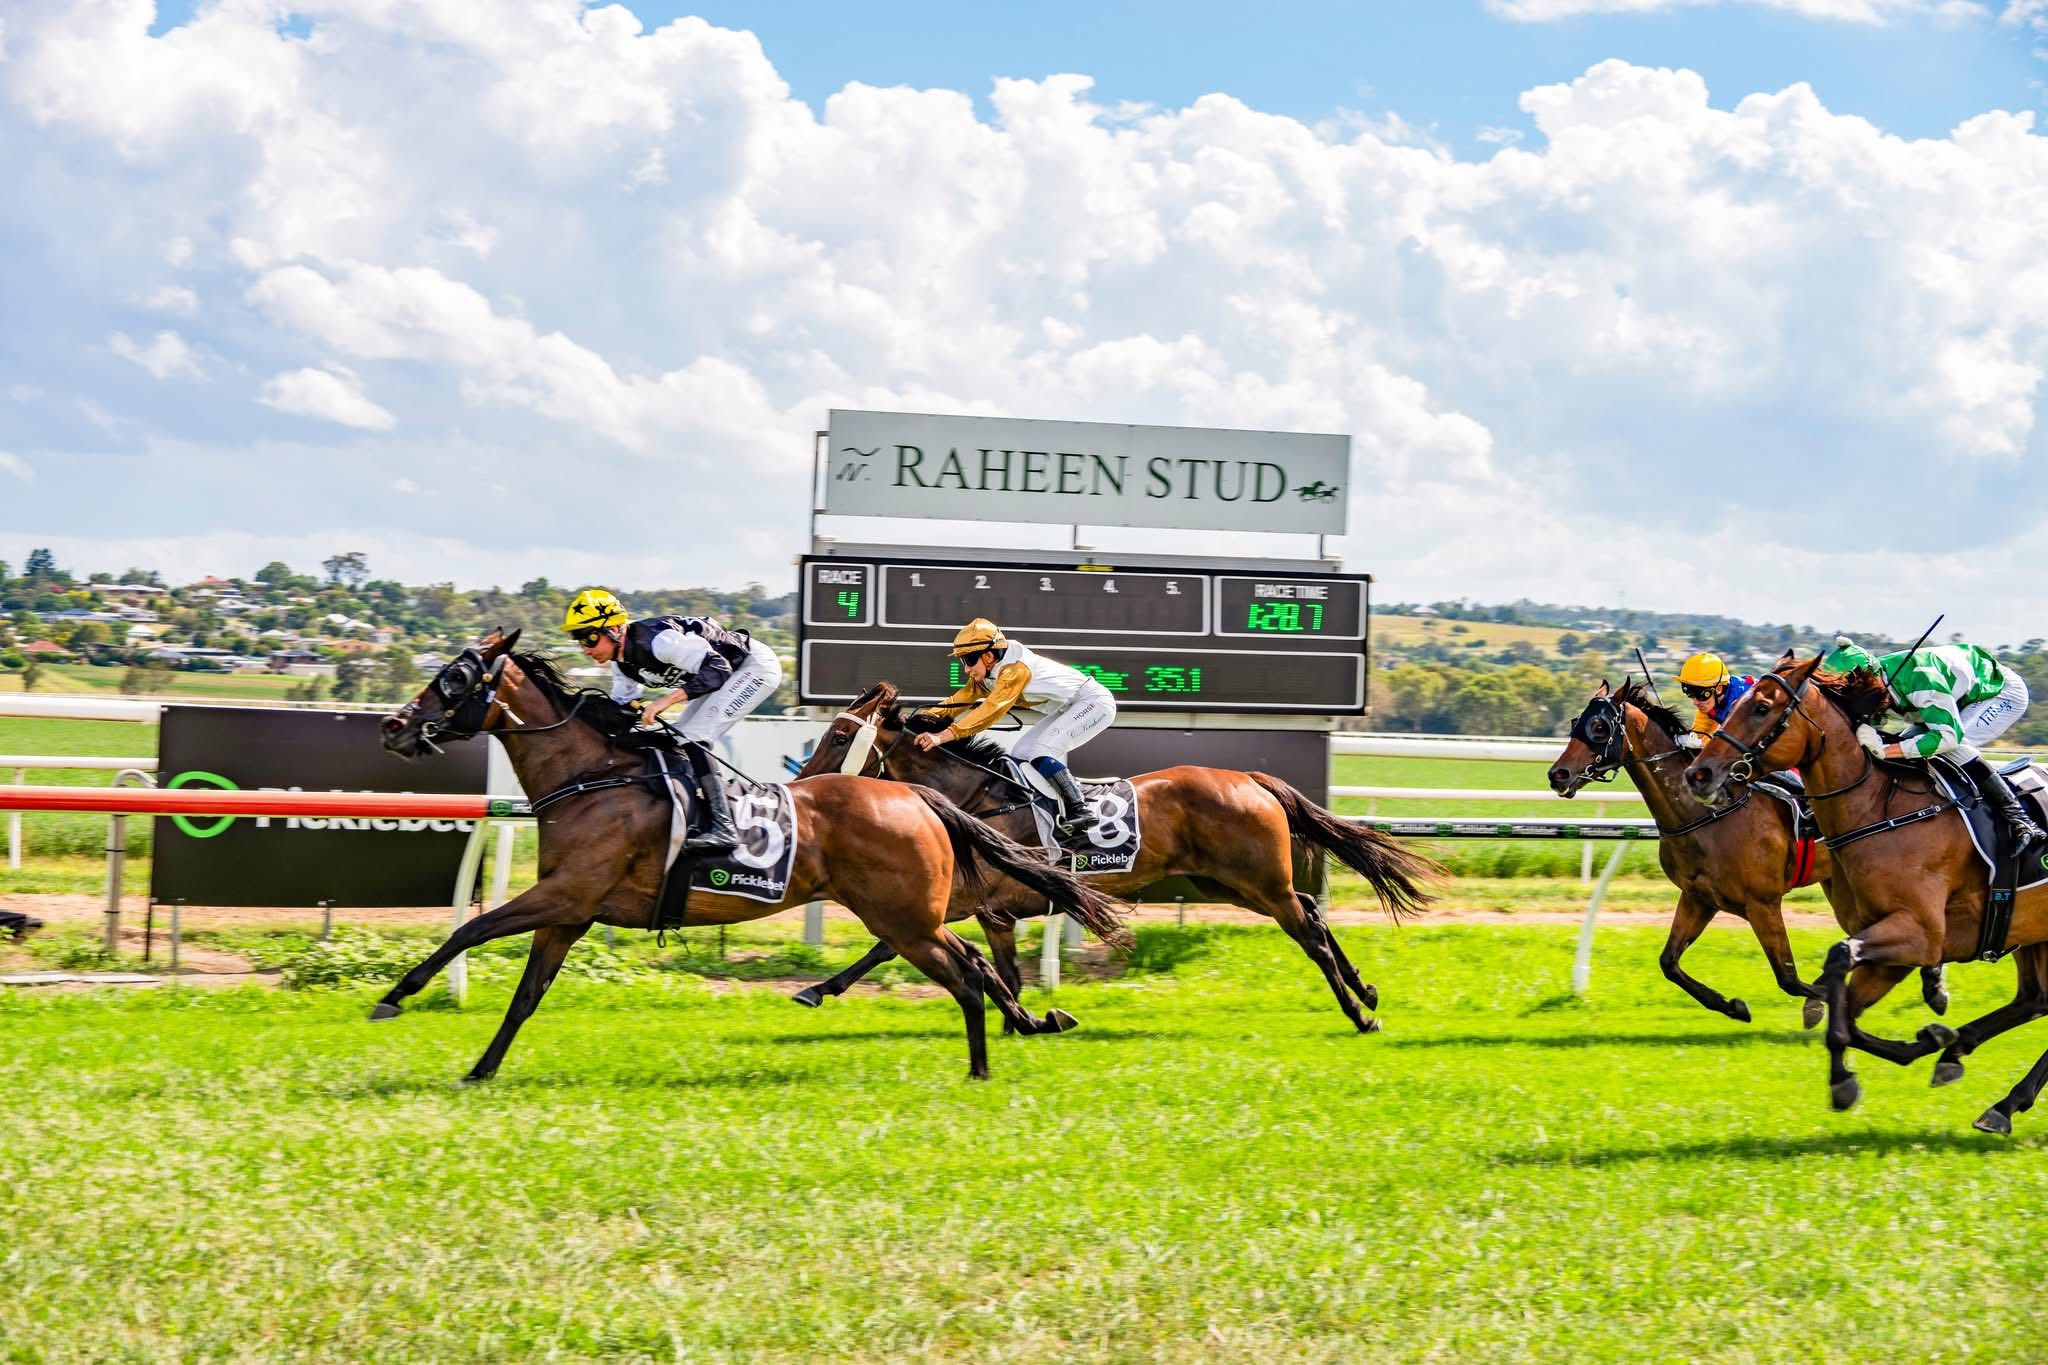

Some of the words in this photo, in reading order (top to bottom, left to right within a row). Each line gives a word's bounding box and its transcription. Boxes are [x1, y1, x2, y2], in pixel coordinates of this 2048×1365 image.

[892, 444, 1128, 496] RAHEEN
[1146, 456, 1287, 503] STUD
[817, 569, 863, 585] RACE
[1254, 583, 1295, 599] RACE
[1296, 585, 1329, 600] TIME
[837, 591, 859, 617] 4
[1073, 702, 1096, 721] HORSE
[731, 793, 786, 869] 5
[1086, 792, 1131, 849] 8
[730, 873, 785, 892] Picklebet
